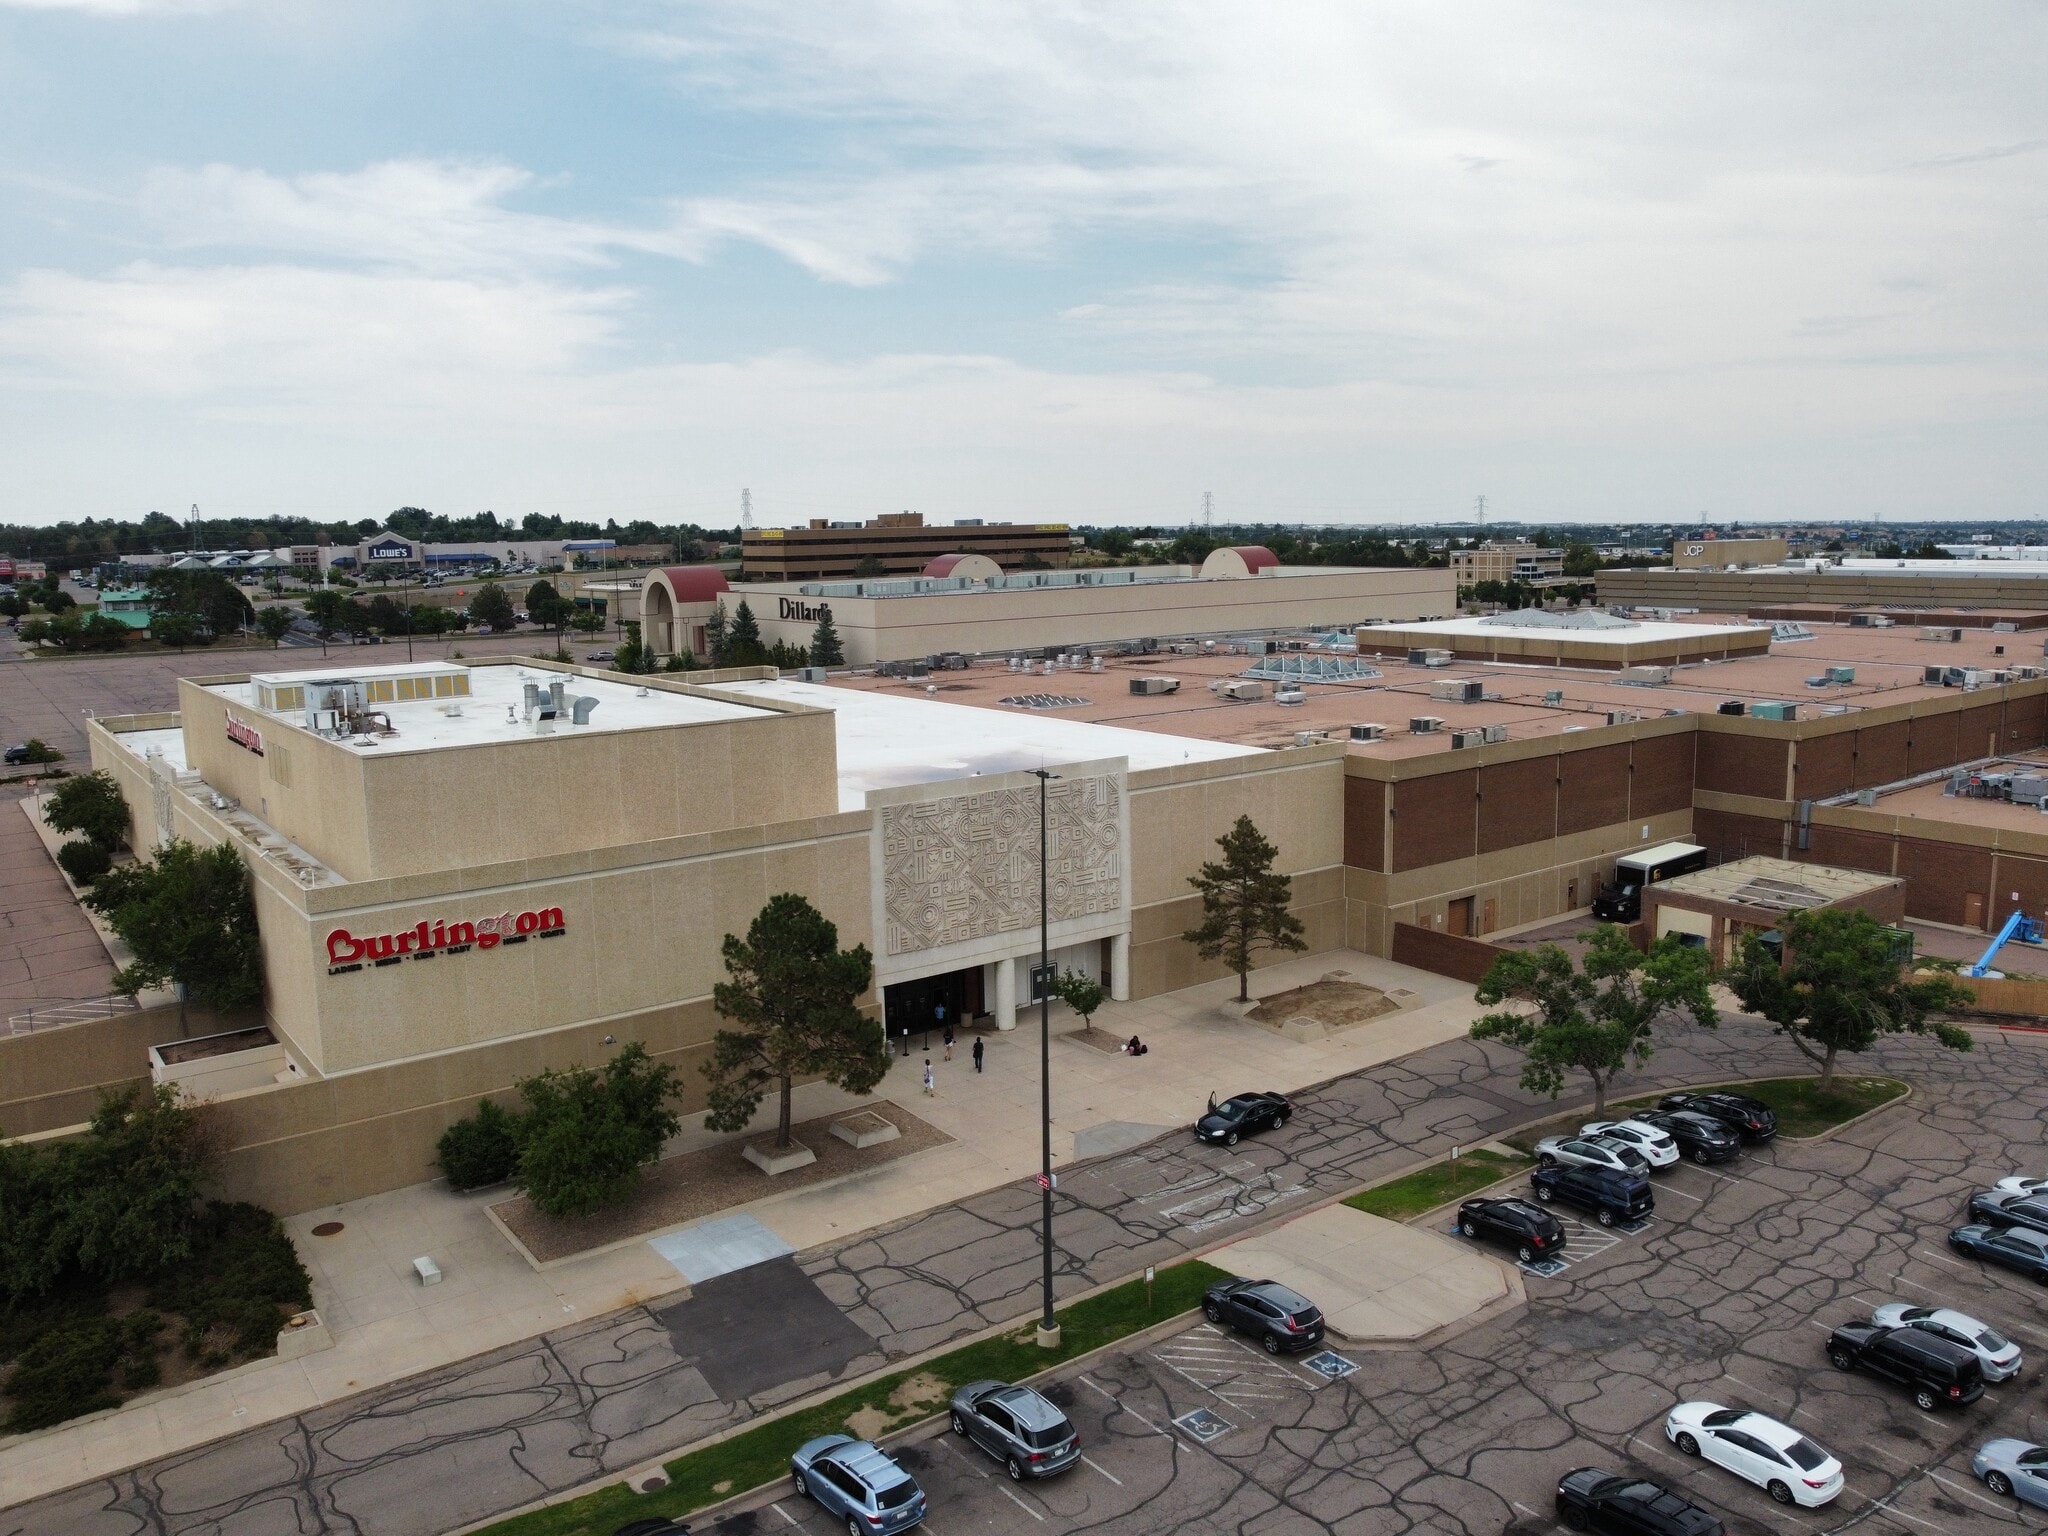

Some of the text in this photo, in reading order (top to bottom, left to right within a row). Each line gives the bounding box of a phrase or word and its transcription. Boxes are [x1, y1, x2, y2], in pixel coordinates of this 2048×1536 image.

[373, 547, 408, 558] LOWE'S
[1683, 545, 1704, 556] JCP
[326, 906, 566, 966] Burlington
[447, 944, 472, 955] BABY
